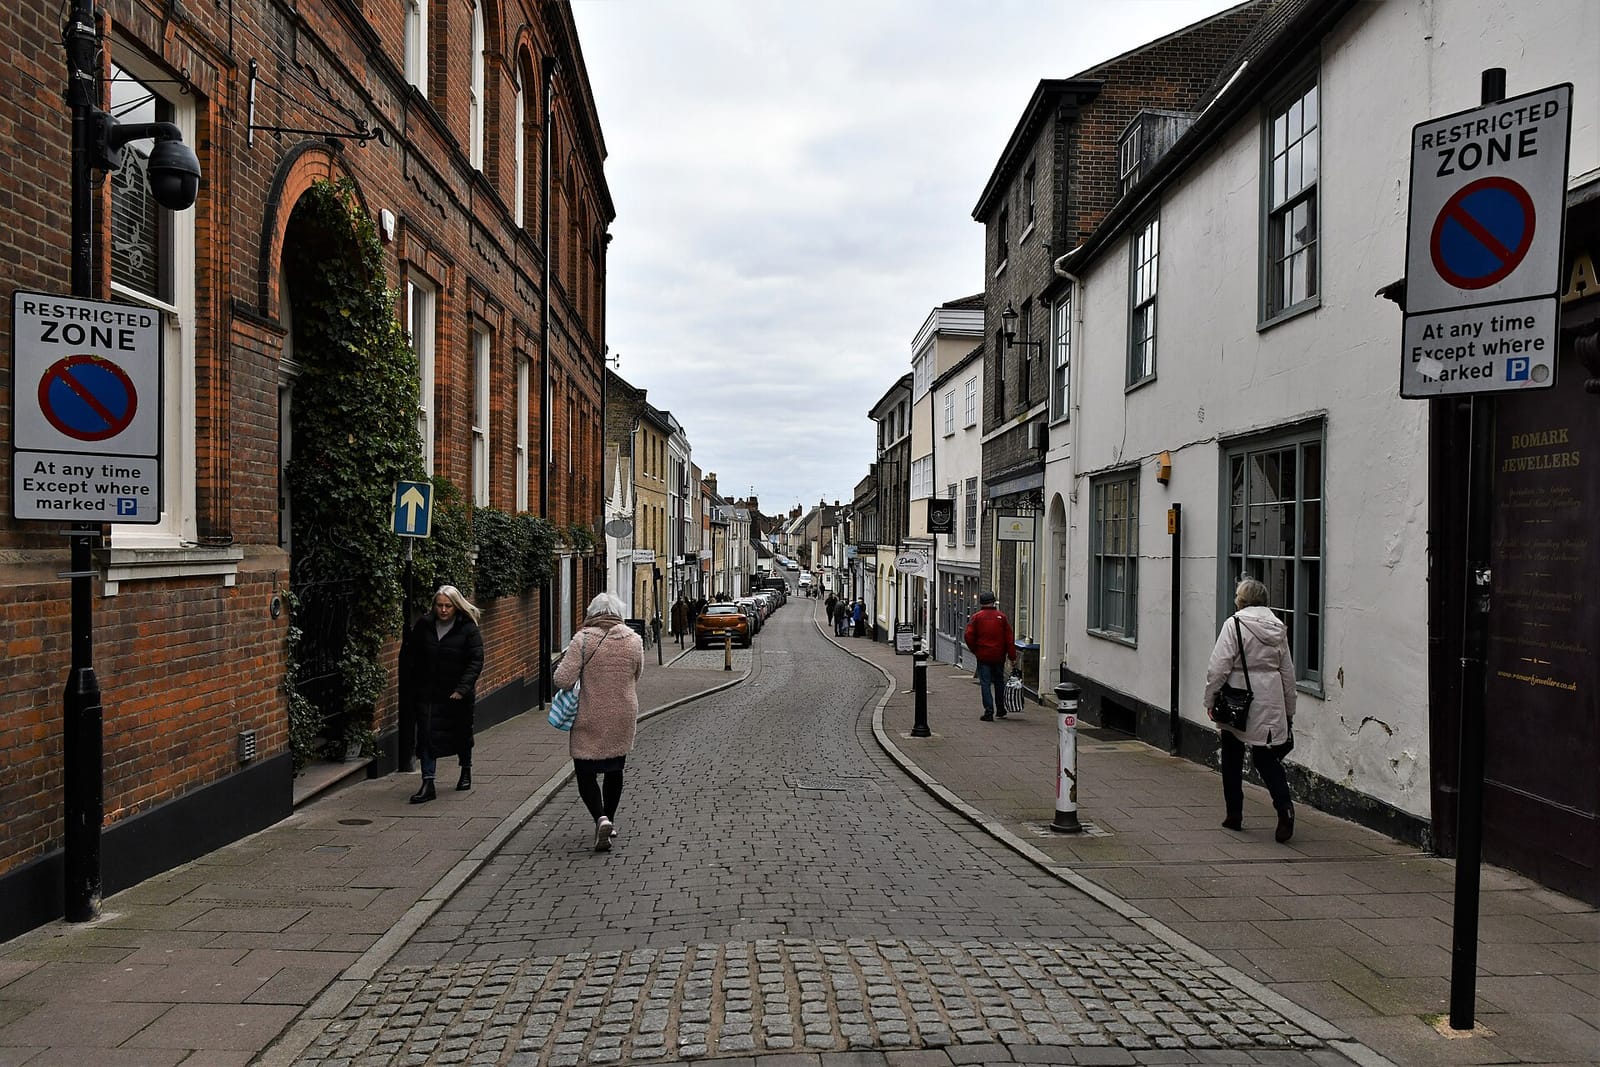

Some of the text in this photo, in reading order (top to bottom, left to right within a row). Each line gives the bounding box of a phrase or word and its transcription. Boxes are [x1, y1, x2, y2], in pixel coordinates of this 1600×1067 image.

[1421, 100, 1559, 150] RESTRICTED
[1436, 127, 1538, 178] ZONE
[23, 301, 151, 328] RESTRICTED
[40, 320, 135, 351] ZONE
[1422, 315, 1535, 340] At any time
[1412, 337, 1545, 363] Except where
[1511, 359, 1526, 380] P
[1511, 428, 1569, 449] ROMARK
[33, 461, 141, 479] At any time
[1502, 451, 1580, 472] JEWELLERS
[23, 477, 150, 495] Except where
[36, 498, 134, 514] marked P
